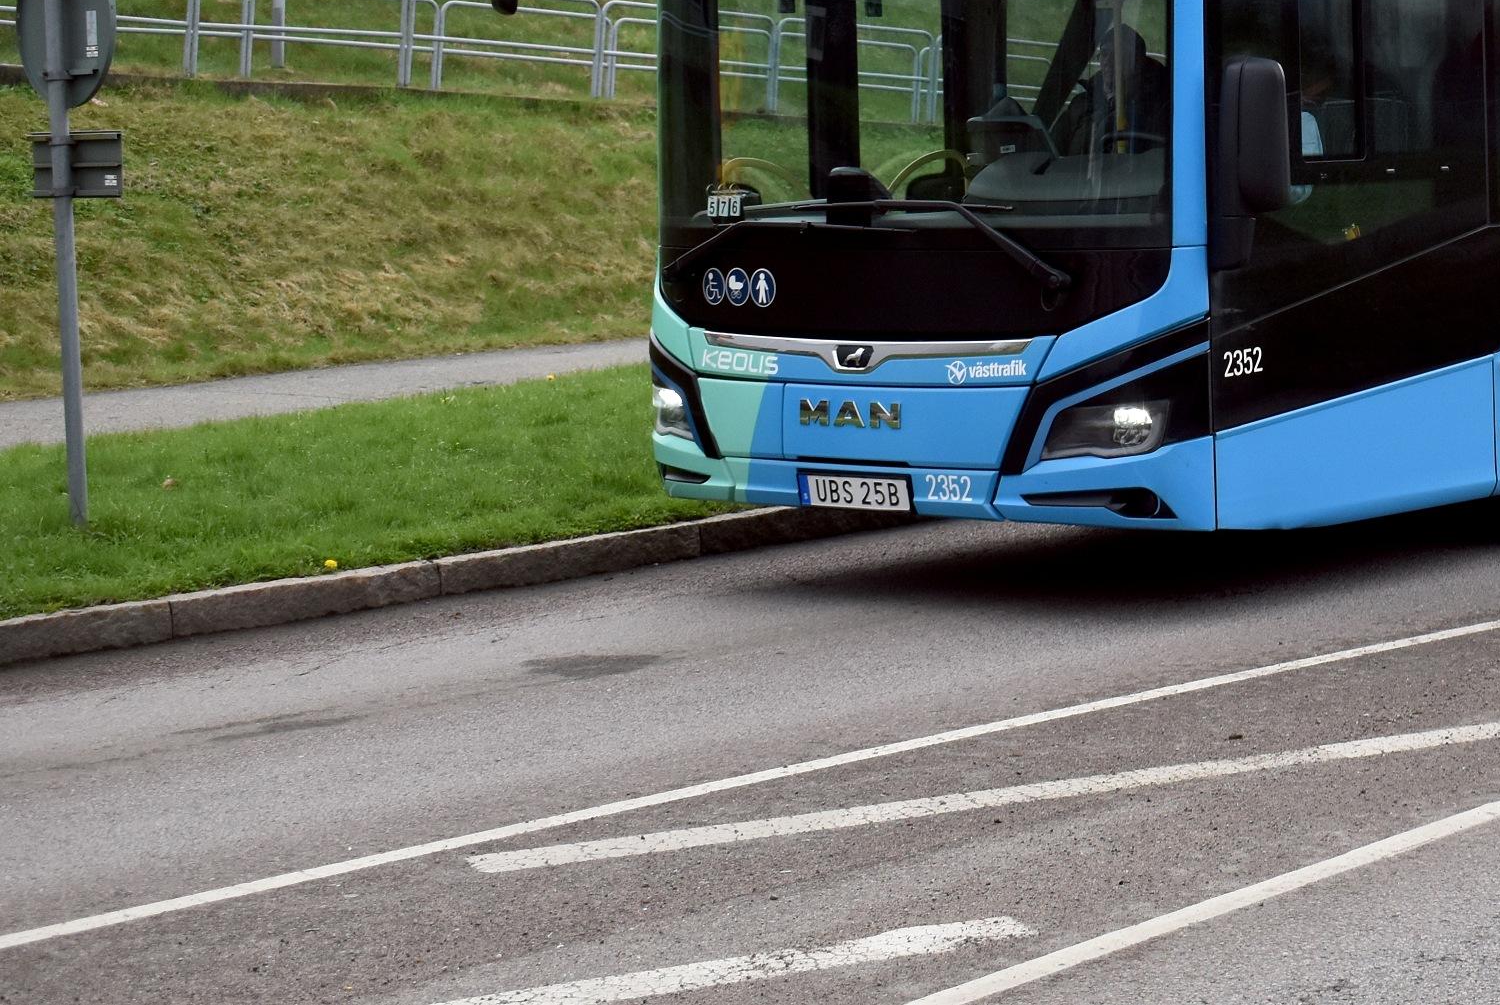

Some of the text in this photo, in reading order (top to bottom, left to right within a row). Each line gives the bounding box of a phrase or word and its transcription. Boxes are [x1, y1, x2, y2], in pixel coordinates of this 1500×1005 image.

[968, 359, 1027, 379] västtrafik
[1223, 346, 1264, 378] 2352
[799, 398, 902, 430] MAN
[815, 479, 900, 506] UBS 25B
[925, 474, 973, 502] 2352
